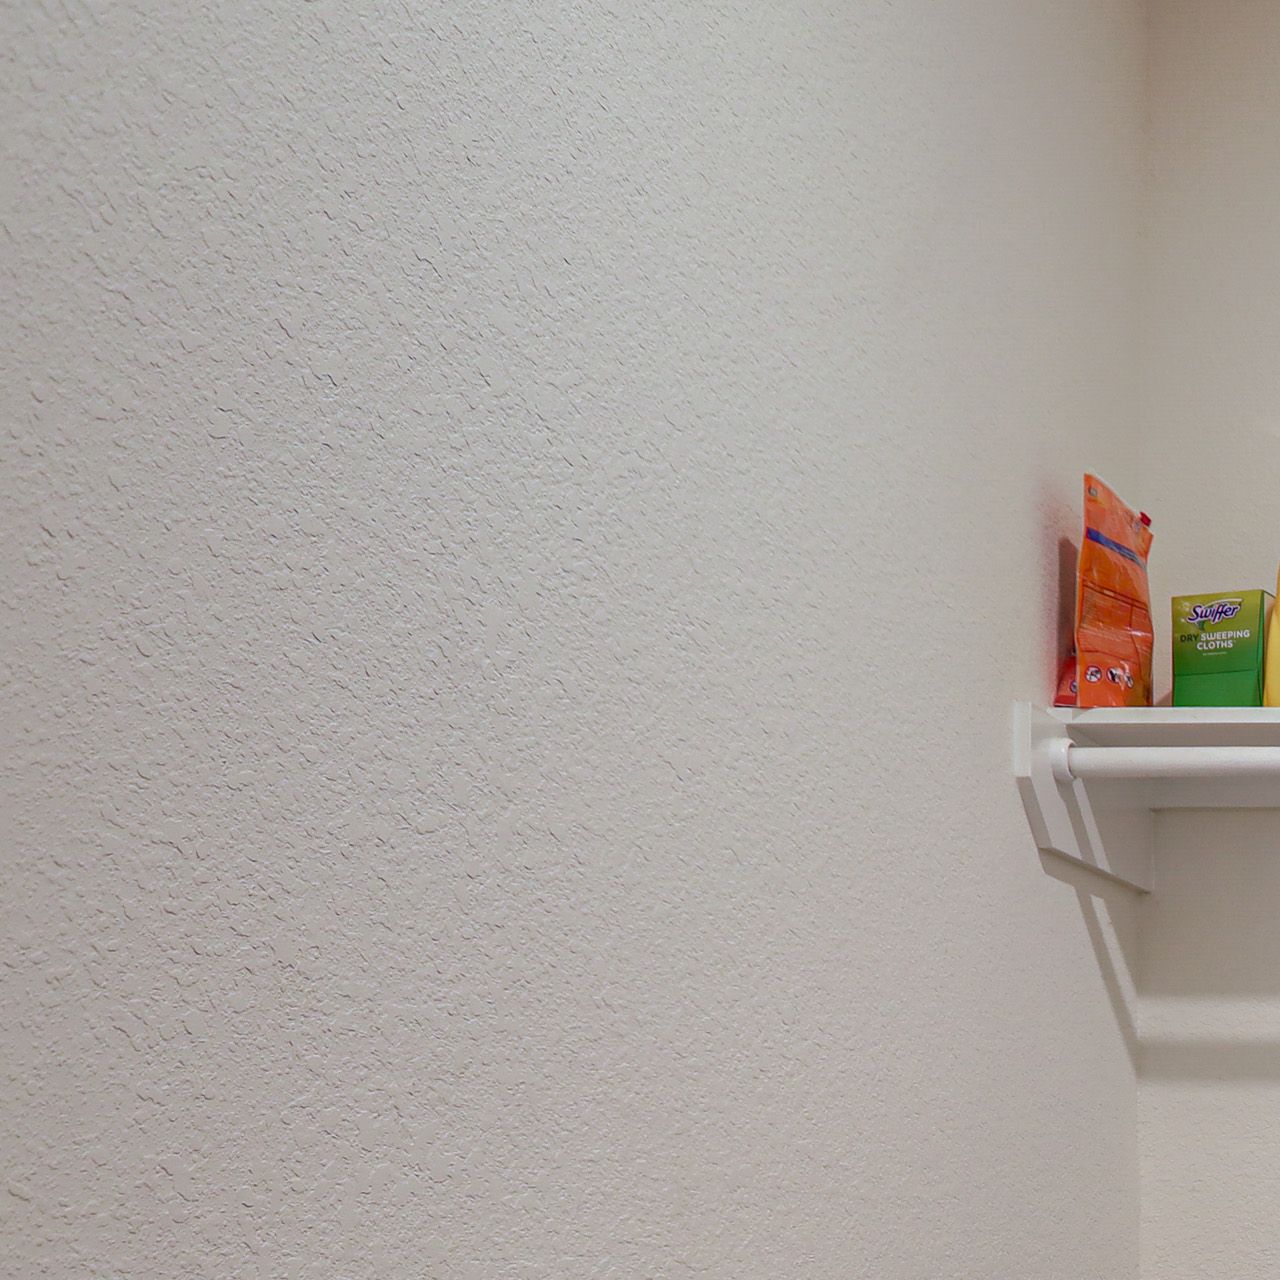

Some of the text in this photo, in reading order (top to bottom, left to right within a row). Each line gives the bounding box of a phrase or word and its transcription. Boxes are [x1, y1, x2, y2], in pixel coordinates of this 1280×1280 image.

[1187, 603, 1239, 622] Swiffer
[1180, 629, 1250, 642] DRY SWEEPING
[1196, 640, 1233, 650] CLOTHS
